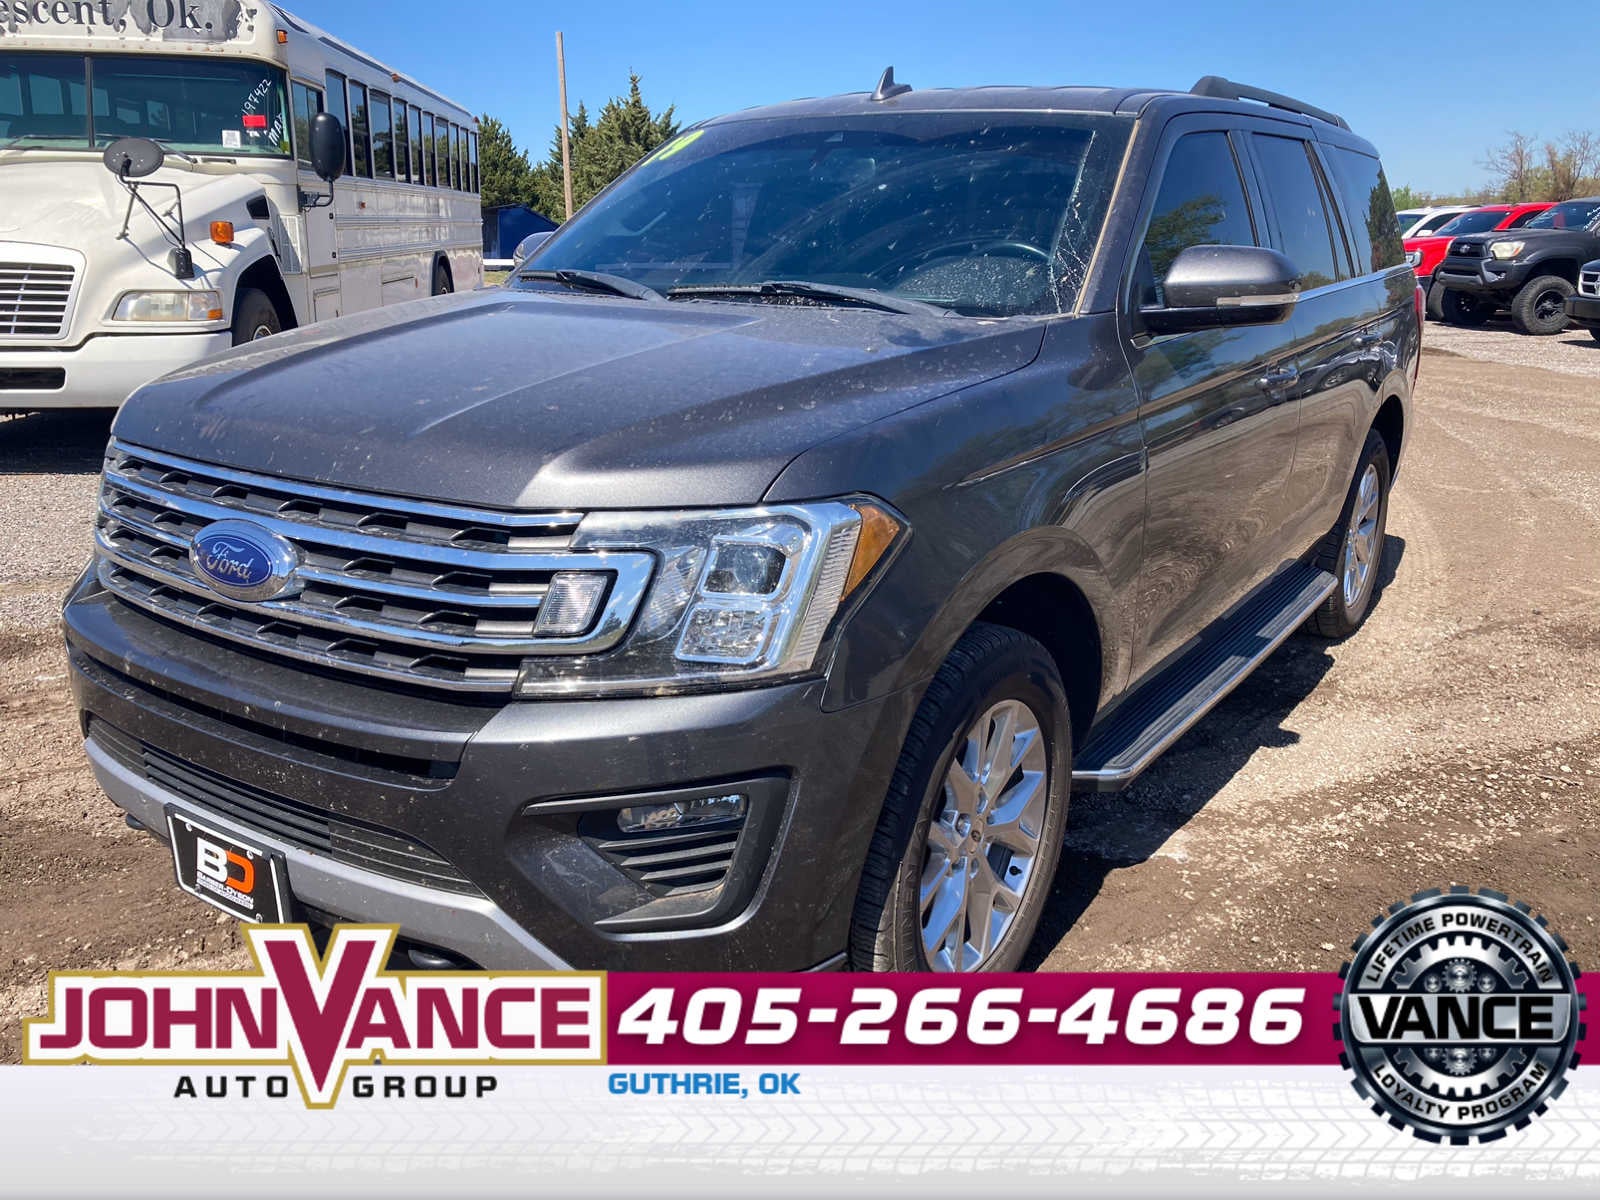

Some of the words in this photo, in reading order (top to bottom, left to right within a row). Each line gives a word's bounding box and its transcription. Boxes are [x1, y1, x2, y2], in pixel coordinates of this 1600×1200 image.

[148, 0, 213, 29] Ok.
[241, 79, 272, 117] 197422
[206, 541, 255, 580] Ford
[197, 838, 254, 894] BD
